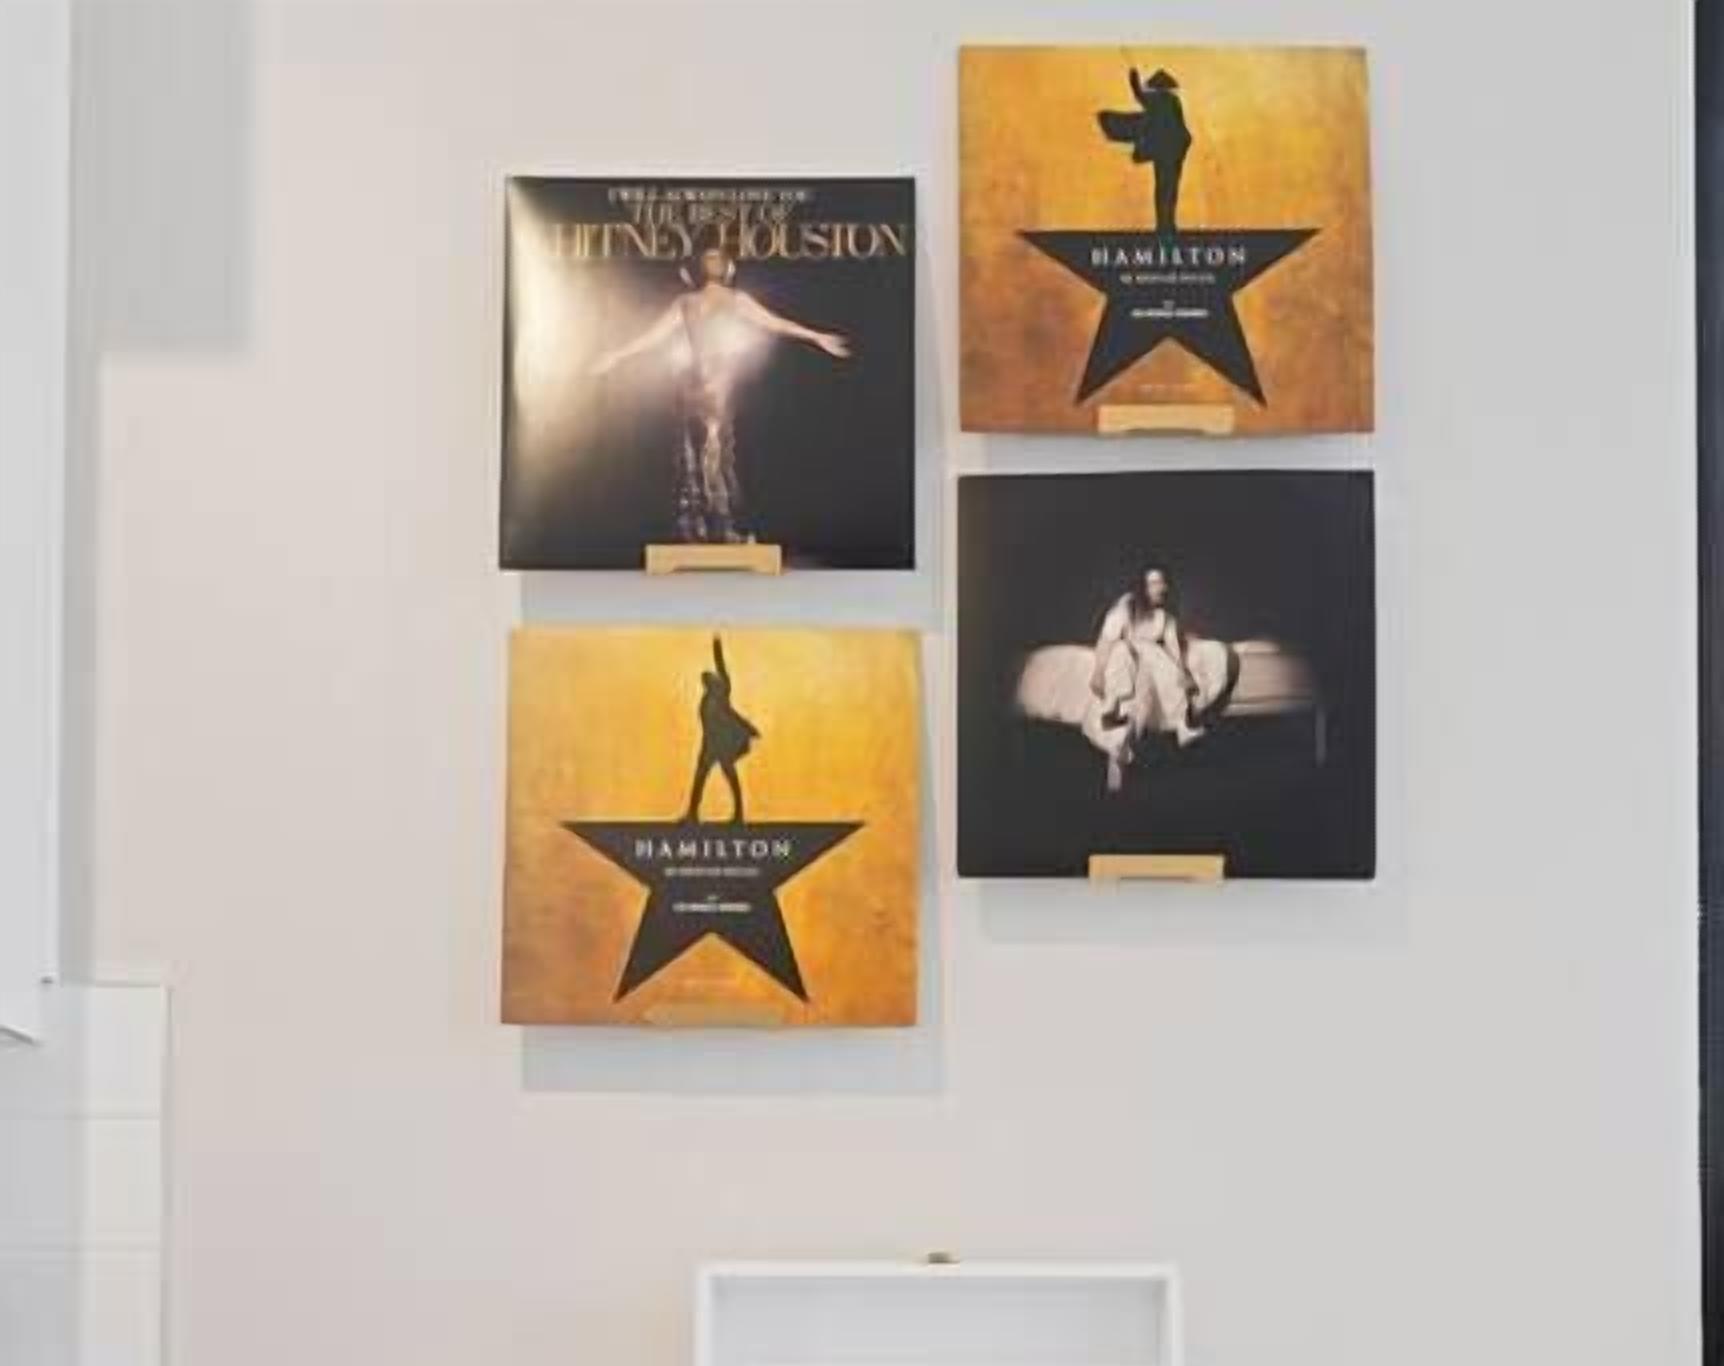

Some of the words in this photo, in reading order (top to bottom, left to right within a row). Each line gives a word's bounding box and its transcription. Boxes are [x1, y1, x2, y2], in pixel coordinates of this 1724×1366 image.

[716, 223, 908, 261] HOUSTON
[1090, 247, 1246, 267] HAMILTON
[634, 839, 792, 860] HAMILTON
